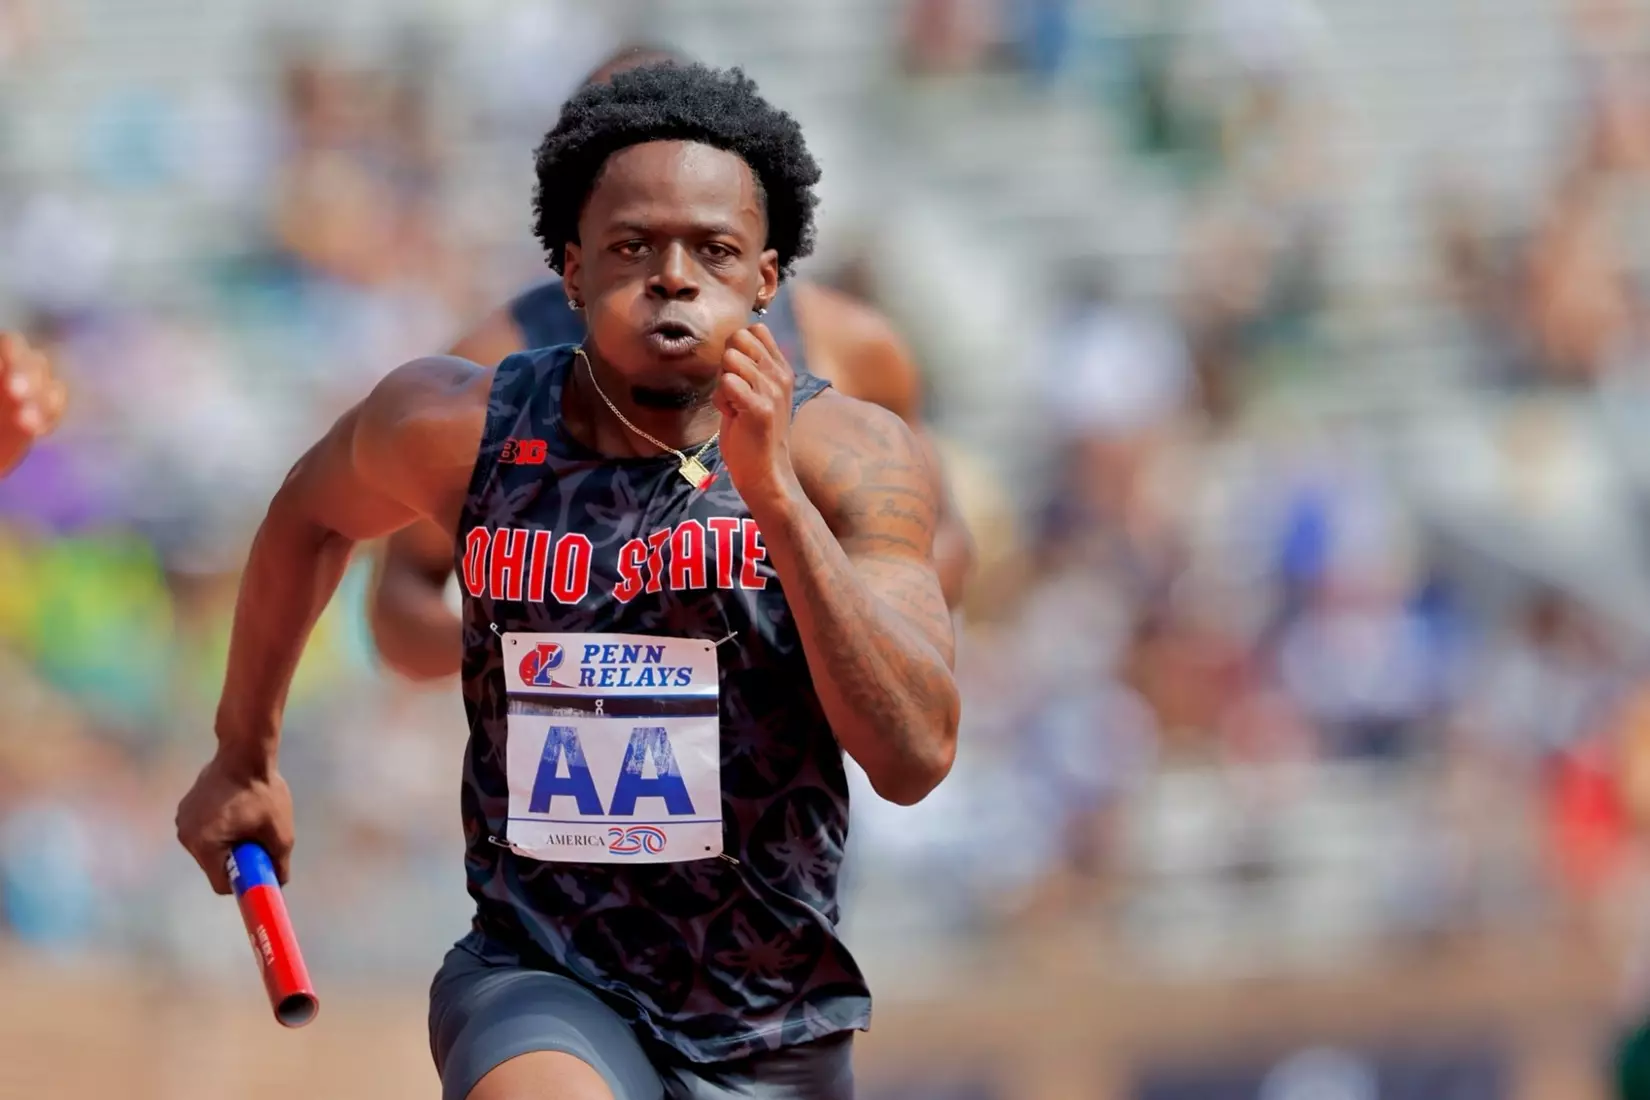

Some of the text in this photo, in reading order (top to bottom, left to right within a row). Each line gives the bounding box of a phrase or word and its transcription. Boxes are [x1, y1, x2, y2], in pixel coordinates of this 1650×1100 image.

[462, 516, 767, 604] OHIO STATE
[580, 644, 666, 664] PENN
[578, 667, 693, 687] RELAYS
[528, 726, 697, 816] AA
[546, 825, 667, 854] AMERICA 250
